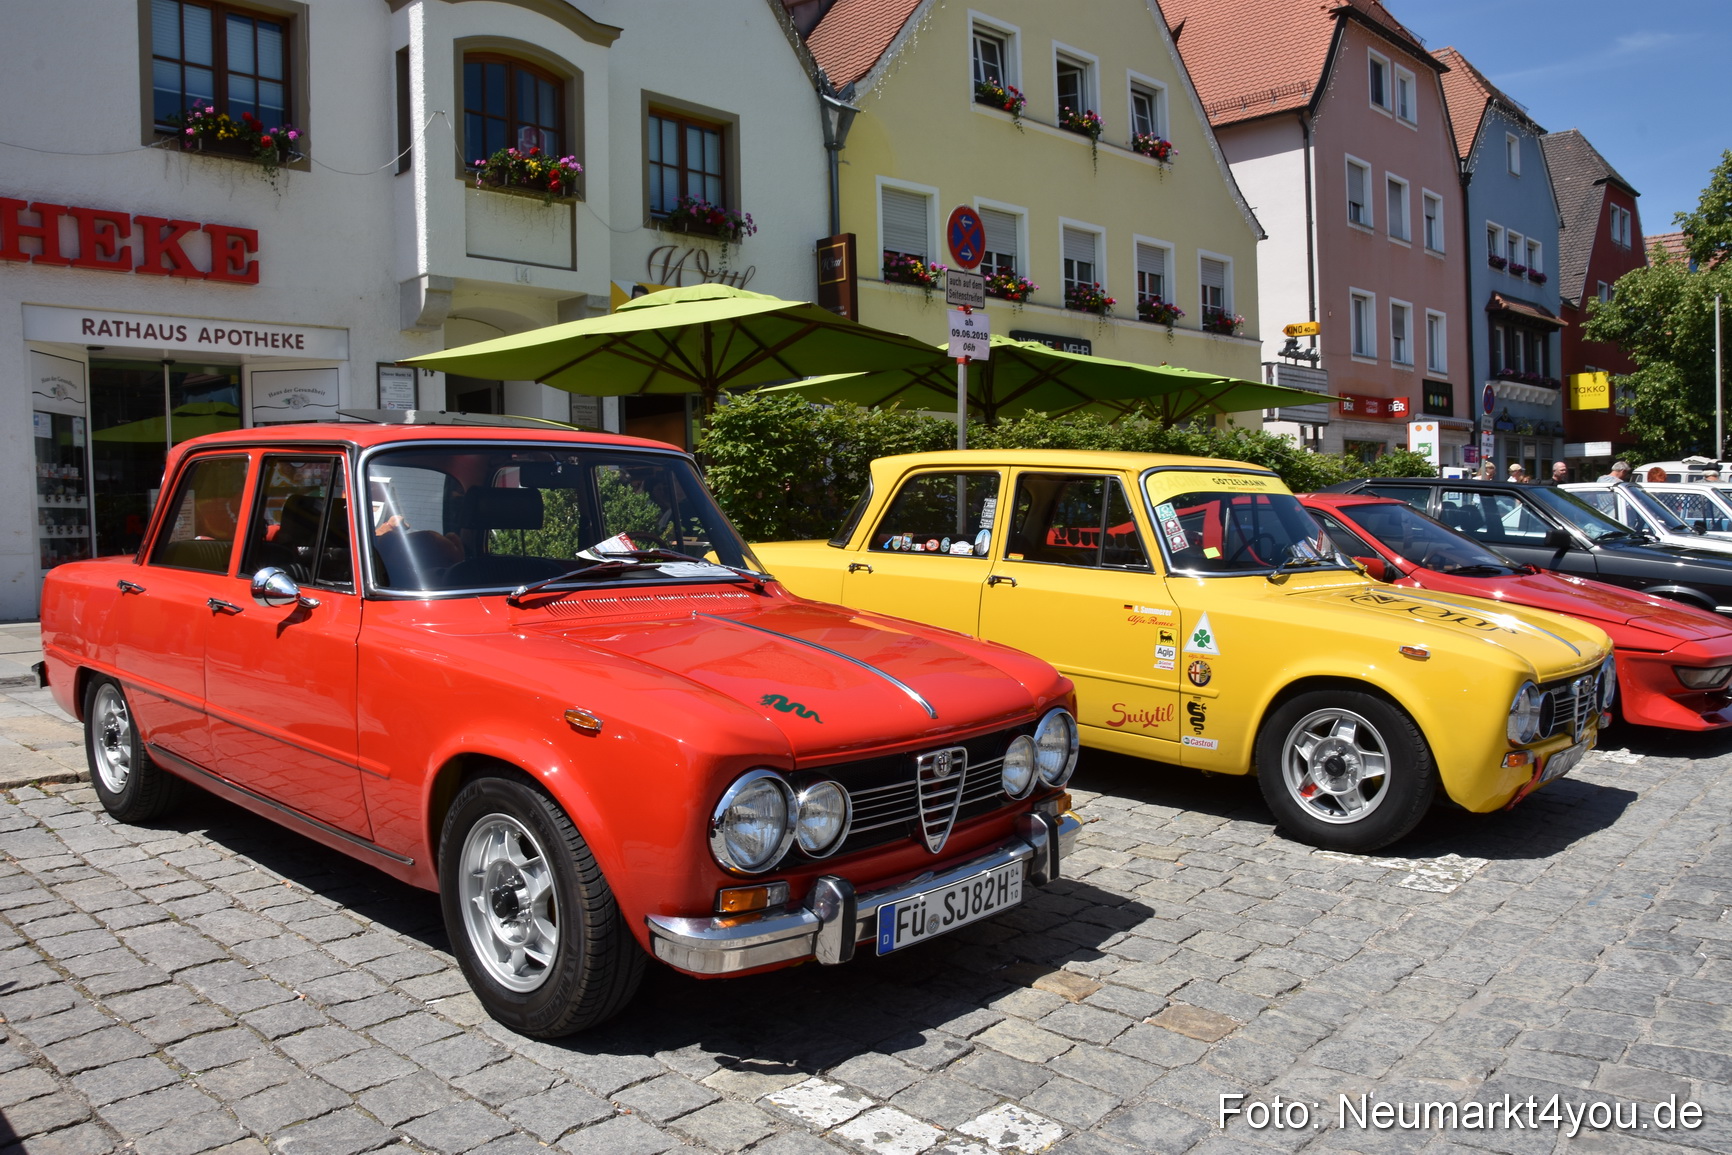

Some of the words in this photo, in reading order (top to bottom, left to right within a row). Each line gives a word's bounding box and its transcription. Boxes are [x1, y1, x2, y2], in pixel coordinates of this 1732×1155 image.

[949, 276, 961, 287] auch
[963, 278, 971, 289] auf
[971, 281, 982, 290] dem
[948, 289, 983, 303] Seitenstreifen
[964, 319, 974, 327] ab
[82, 318, 188, 342] RATHAUS
[198, 327, 305, 350] APOTHEKE
[951, 329, 988, 340] 09.06.2019
[1286, 325, 1303, 335] KINO
[963, 342, 976, 351] 06h
[268, 390, 282, 398] Haus
[294, 387, 326, 396] Gesundheit
[1388, 402, 1405, 412] DER
[1134, 605, 1140, 613] A.
[1157, 647, 1174, 657] Agip
[1105, 703, 1174, 728] Suixtil
[1190, 739, 1214, 748] Castrol
[1011, 867, 1019, 878] 04
[1010, 890, 1019, 900] 10
[883, 934, 889, 945] D
[896, 901, 927, 943] FÜ
[942, 871, 1009, 926] SJ82H
